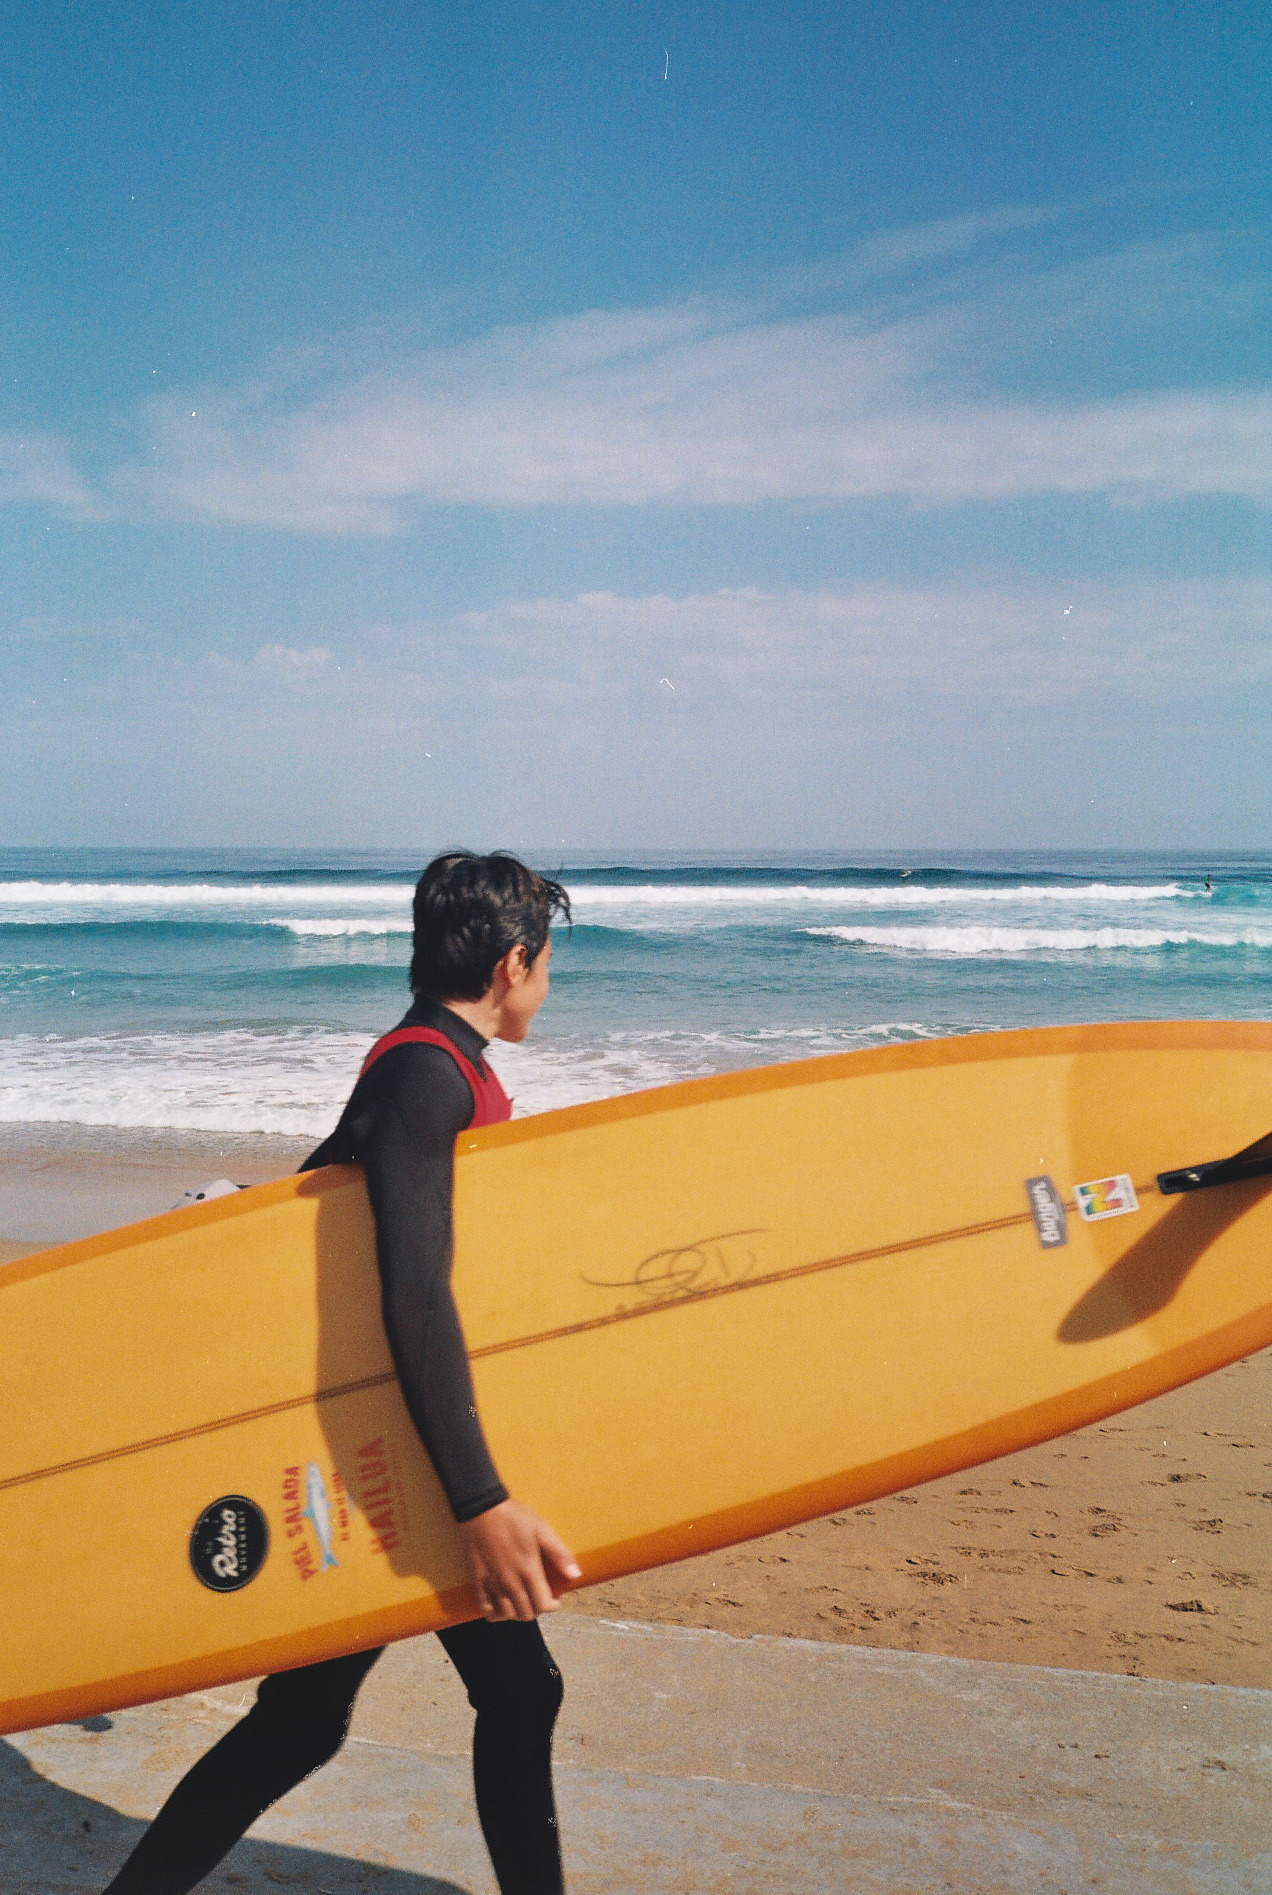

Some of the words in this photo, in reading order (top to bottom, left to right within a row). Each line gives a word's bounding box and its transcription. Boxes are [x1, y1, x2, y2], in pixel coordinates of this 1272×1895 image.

[282, 1466, 304, 1539] SALADA
[211, 1508, 239, 1578] Retro
[291, 1541, 318, 1581] PIEL
